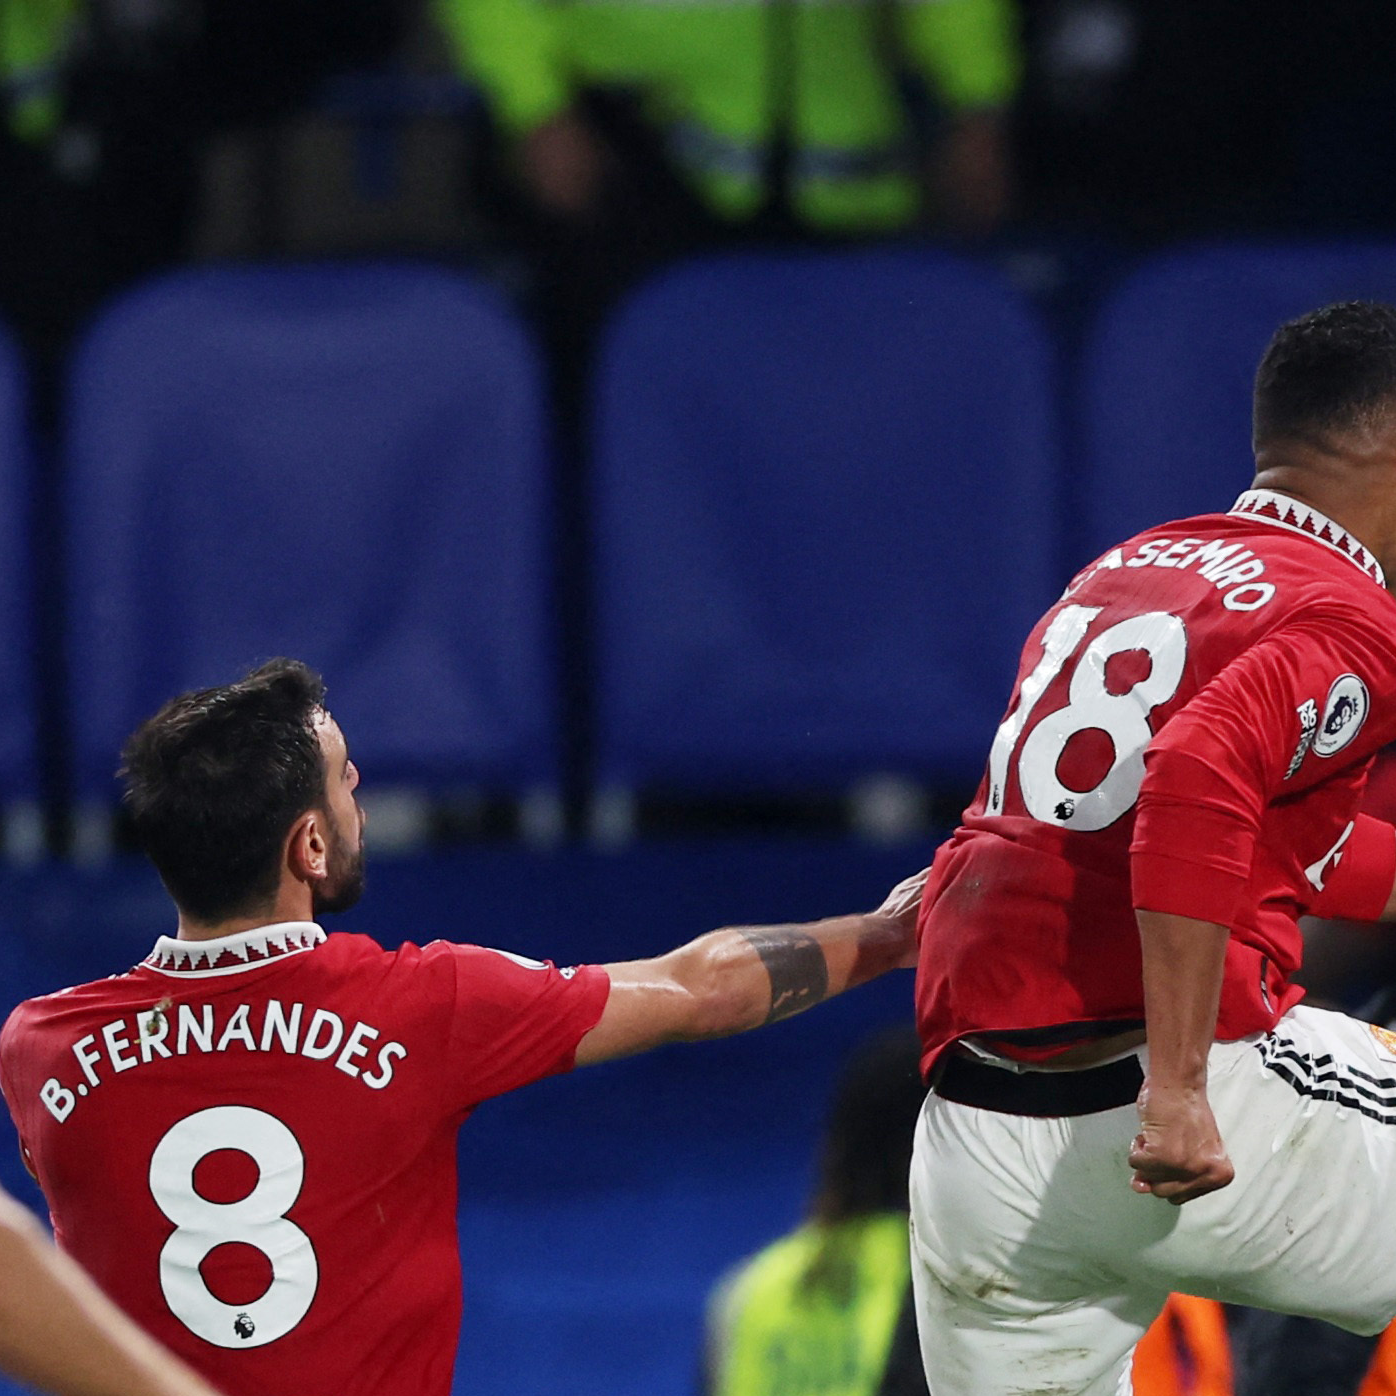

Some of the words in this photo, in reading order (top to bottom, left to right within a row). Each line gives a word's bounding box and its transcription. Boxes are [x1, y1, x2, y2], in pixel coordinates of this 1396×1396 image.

[984, 603, 1188, 832] 18
[39, 999, 407, 1124] B.FERNANDES
[148, 1104, 320, 1350] 8
